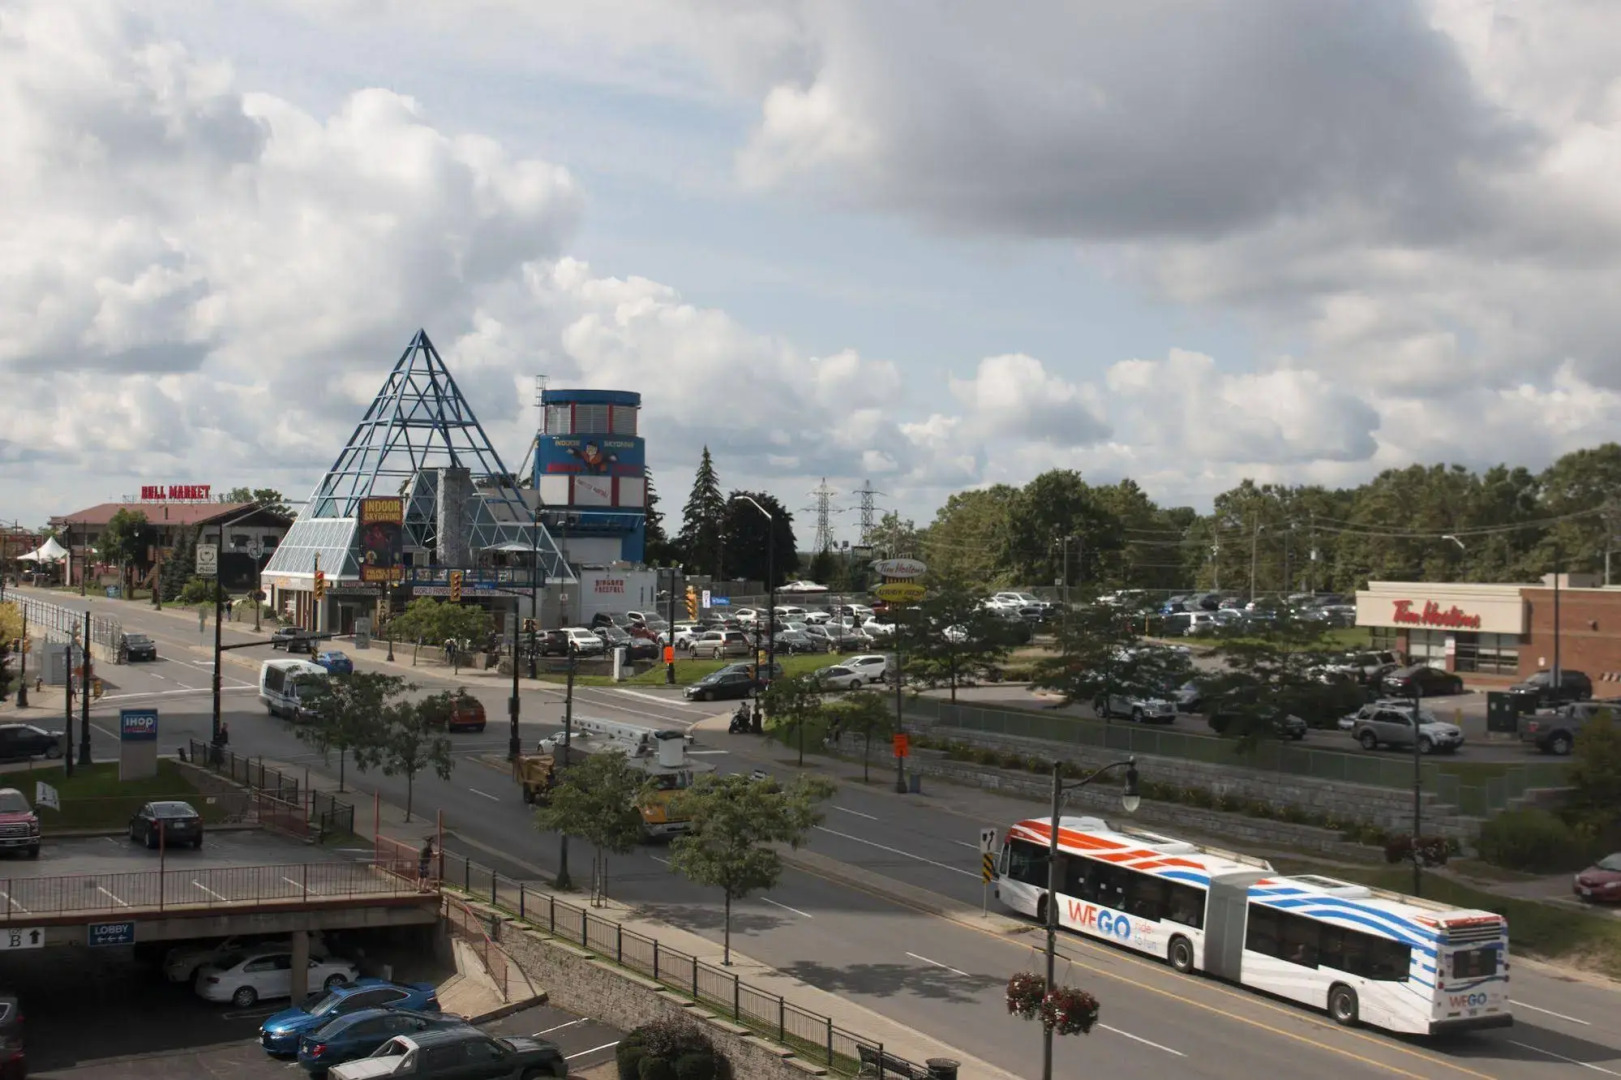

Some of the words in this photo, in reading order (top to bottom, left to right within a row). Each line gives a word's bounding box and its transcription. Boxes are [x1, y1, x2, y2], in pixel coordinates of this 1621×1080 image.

[169, 485, 211, 499] MARKET
[364, 500, 401, 512] INDOOR
[364, 512, 401, 521] SKYDIVING
[1392, 600, 1421, 626] Tim
[1421, 599, 1481, 629] Hortons
[1068, 899, 1131, 942] WEGO
[94, 924, 129, 935] LOBBY
[9, 934, 21, 947] B
[1449, 992, 1487, 1009] WEGO
